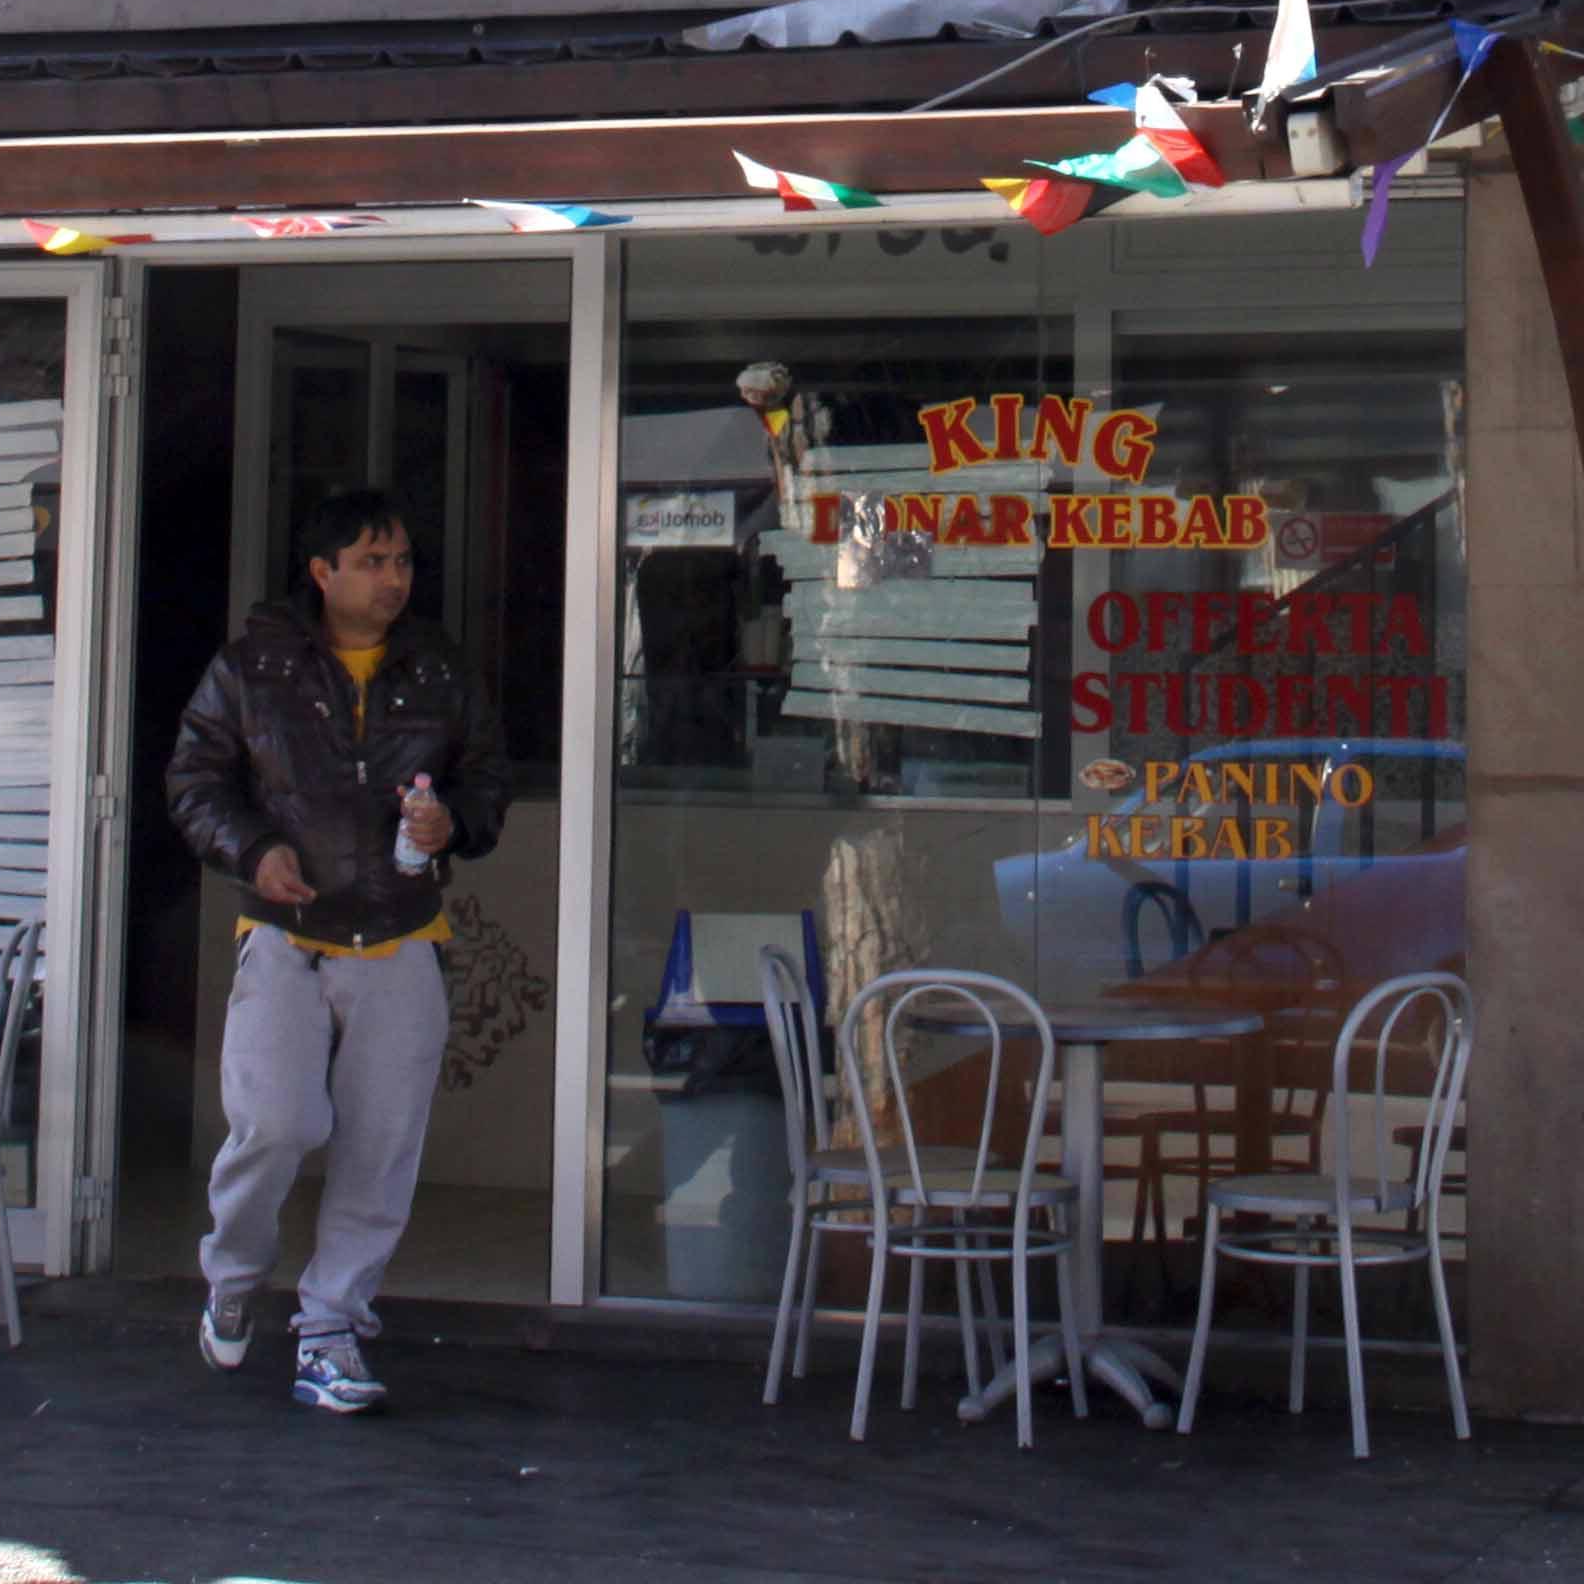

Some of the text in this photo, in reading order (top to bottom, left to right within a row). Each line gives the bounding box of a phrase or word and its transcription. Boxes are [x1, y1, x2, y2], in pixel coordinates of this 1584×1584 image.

[918, 392, 1157, 483] KING
[1048, 491, 1270, 549] KEBAB
[1087, 591, 1429, 656] OFFERTA
[1070, 671, 1450, 738] STUDENTI
[1143, 760, 1375, 808] PANINO
[1085, 813, 1295, 861] KEBAB
